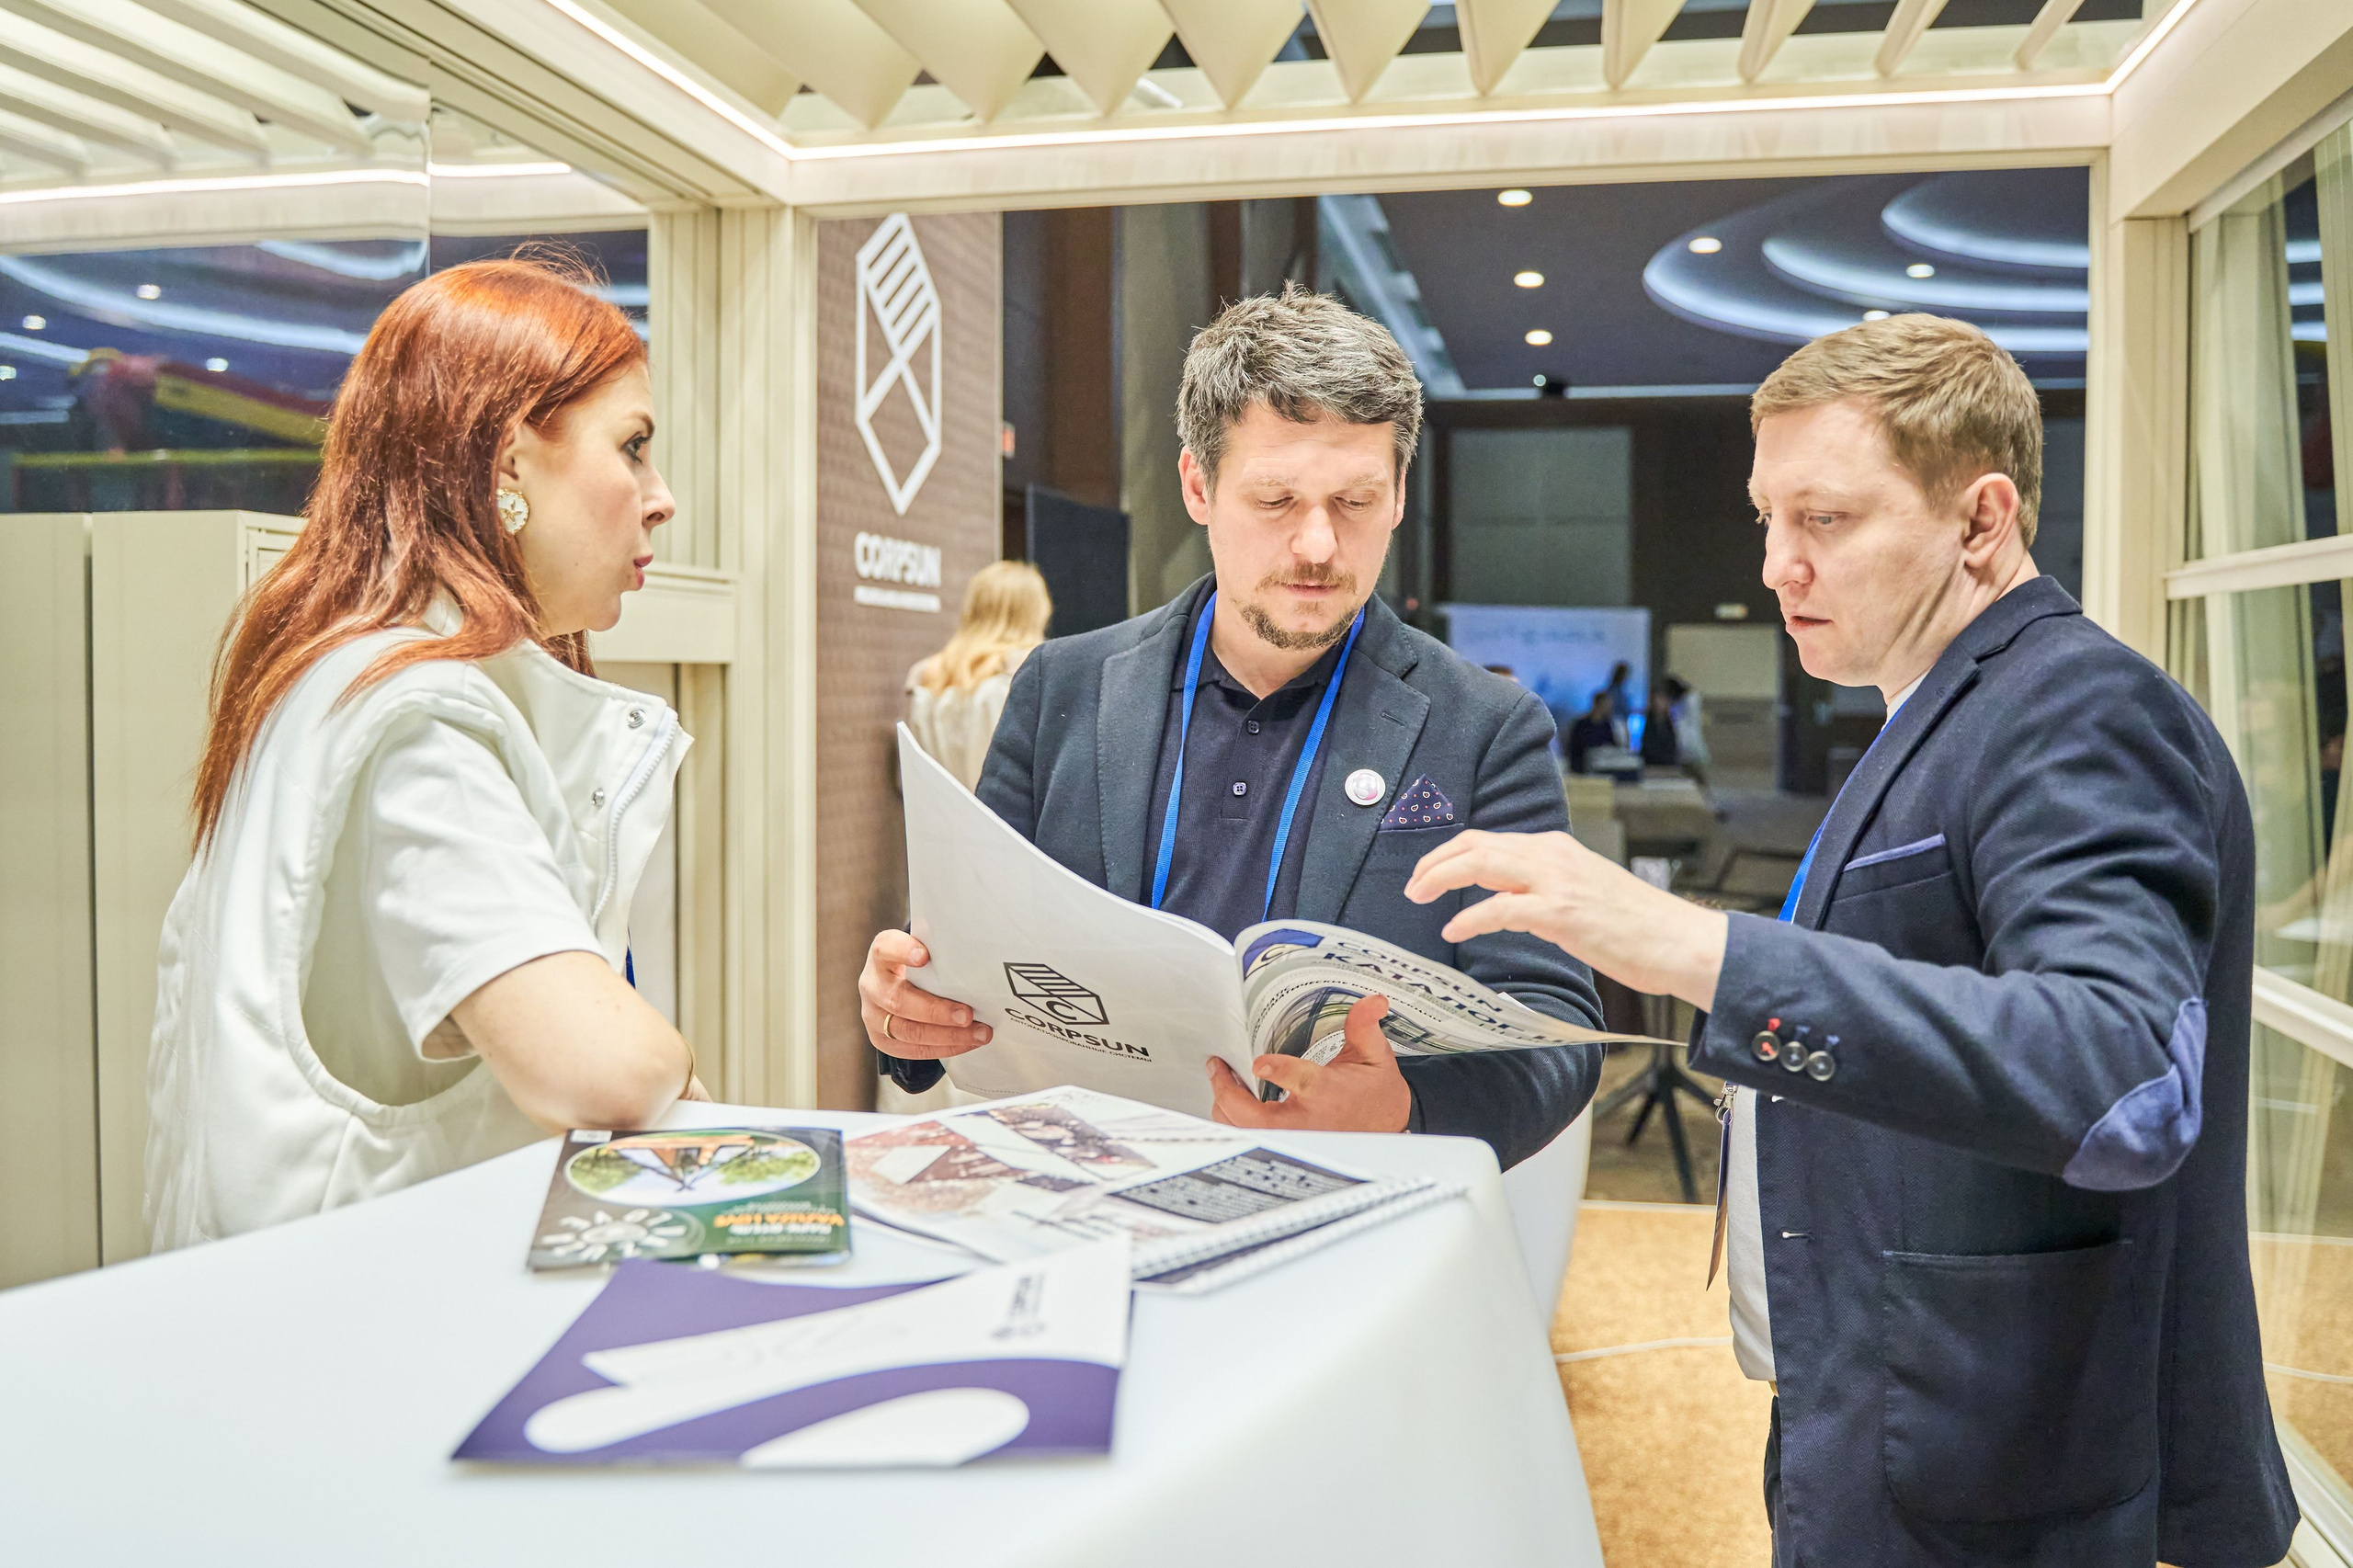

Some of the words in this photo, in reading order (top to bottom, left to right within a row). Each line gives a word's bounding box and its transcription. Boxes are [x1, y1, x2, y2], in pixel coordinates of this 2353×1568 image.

[853, 530, 941, 588] CORPSUN
[1337, 942, 1503, 1013] CORPSUN
[1005, 1007, 1150, 1057] CORPSUN
[1109, 1051, 1153, 1062] СИСТЕМЫ
